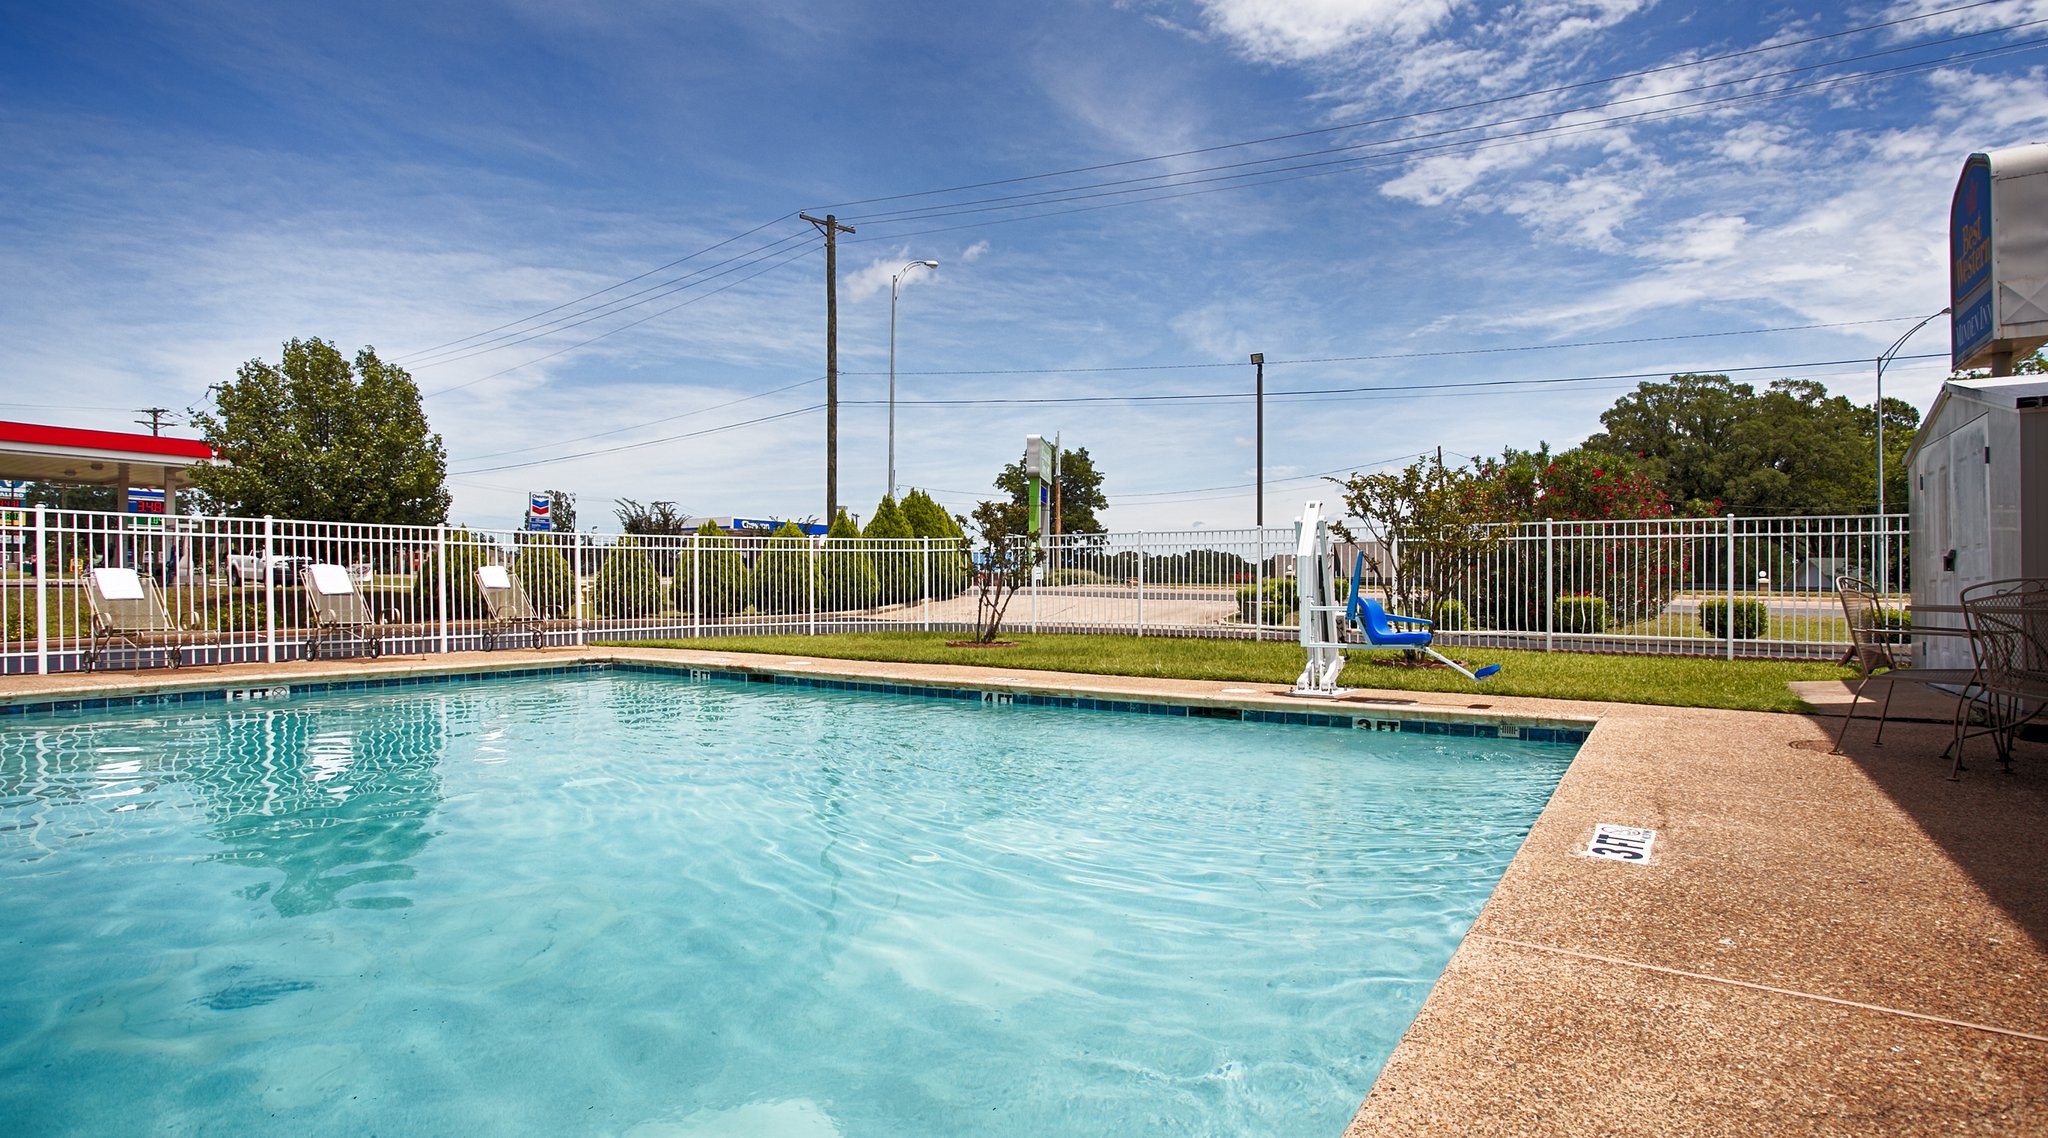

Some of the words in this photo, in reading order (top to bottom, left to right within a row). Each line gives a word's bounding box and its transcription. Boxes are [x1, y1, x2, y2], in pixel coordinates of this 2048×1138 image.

[1962, 213, 1982, 256] Best
[1955, 236, 1991, 288] Western
[700, 671, 710, 679] FT
[250, 688, 269, 699] FT
[984, 692, 993, 702] 4
[997, 693, 1013, 703] FT
[1357, 718, 1372, 730] 3
[1376, 720, 1400, 732] FT
[1595, 833, 1646, 850] FT
[1591, 847, 1644, 860] 3
